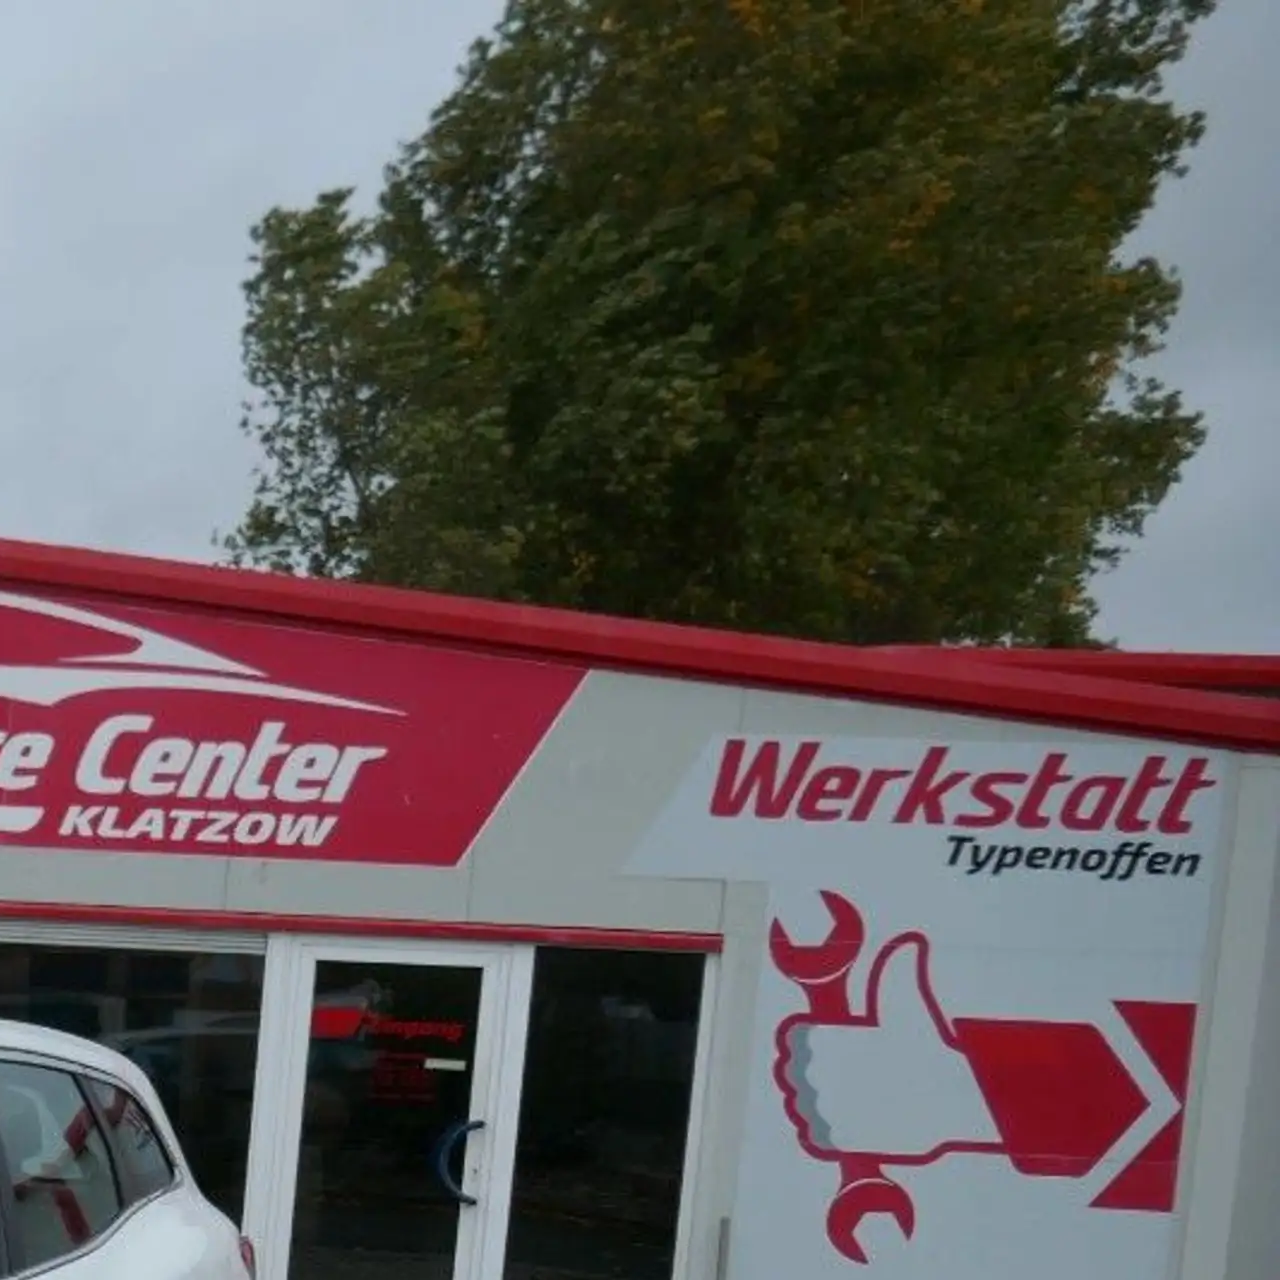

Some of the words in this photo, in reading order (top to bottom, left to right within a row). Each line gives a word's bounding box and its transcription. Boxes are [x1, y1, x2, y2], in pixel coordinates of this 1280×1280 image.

[75, 713, 388, 803] Center
[708, 738, 1217, 835] Werkstatt
[58, 804, 339, 847] KLATZOW
[945, 834, 1202, 881] Typenoffen
